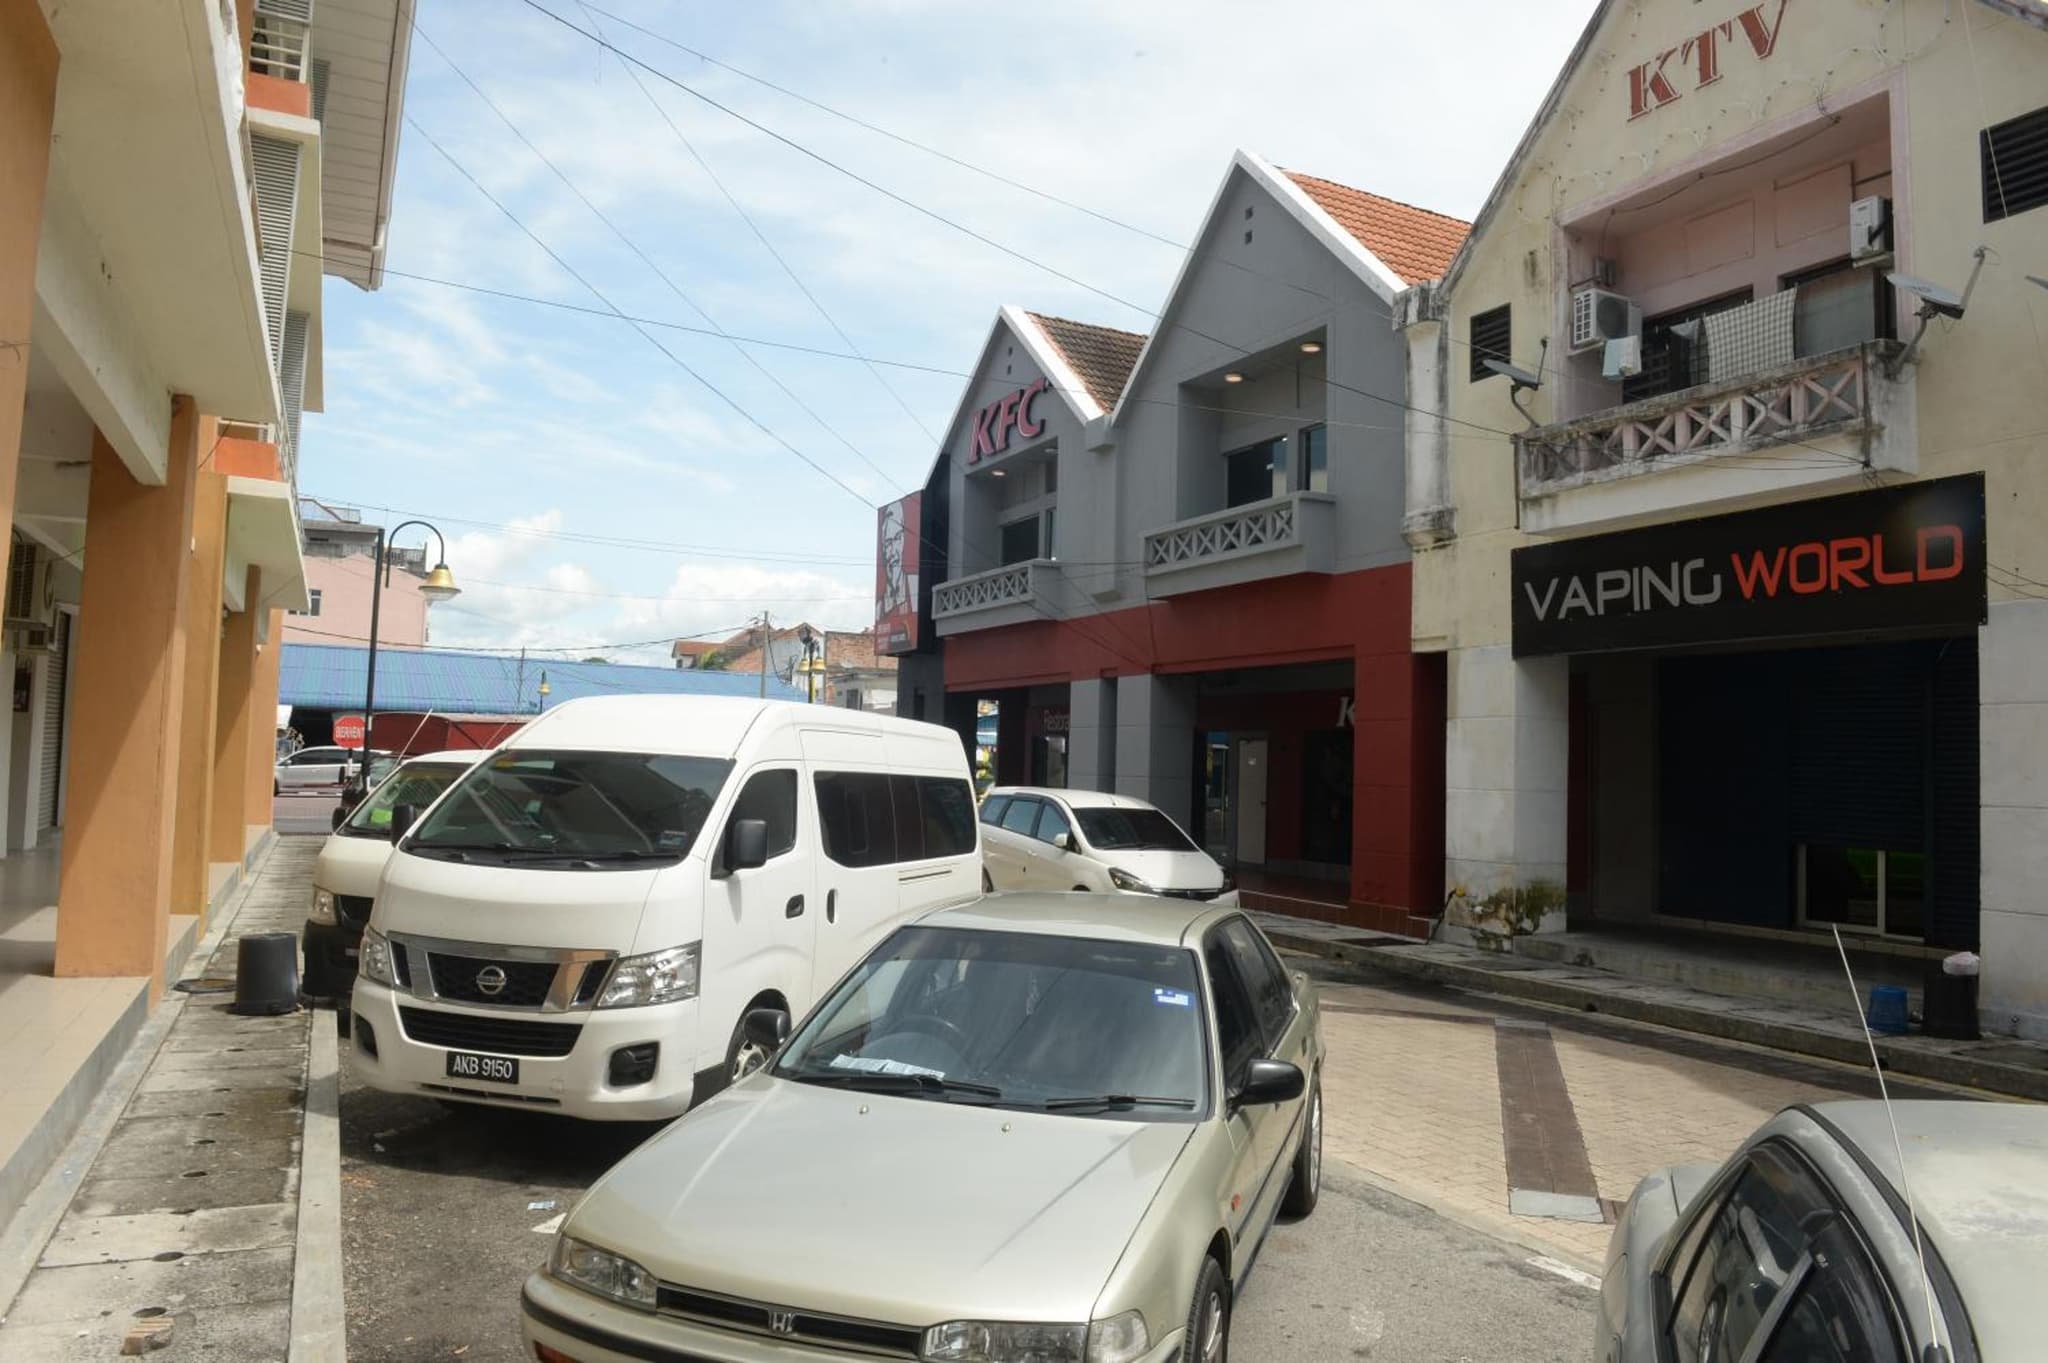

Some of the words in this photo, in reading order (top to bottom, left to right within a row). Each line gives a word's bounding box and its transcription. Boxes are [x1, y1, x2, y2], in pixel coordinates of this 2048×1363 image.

[1626, 0, 1787, 122] KTV
[967, 376, 1047, 465] KFC
[1523, 557, 1722, 622] VAPING
[1730, 524, 1965, 600] WORLD
[452, 1055, 479, 1075] AKB
[481, 1058, 513, 1079] 9150
